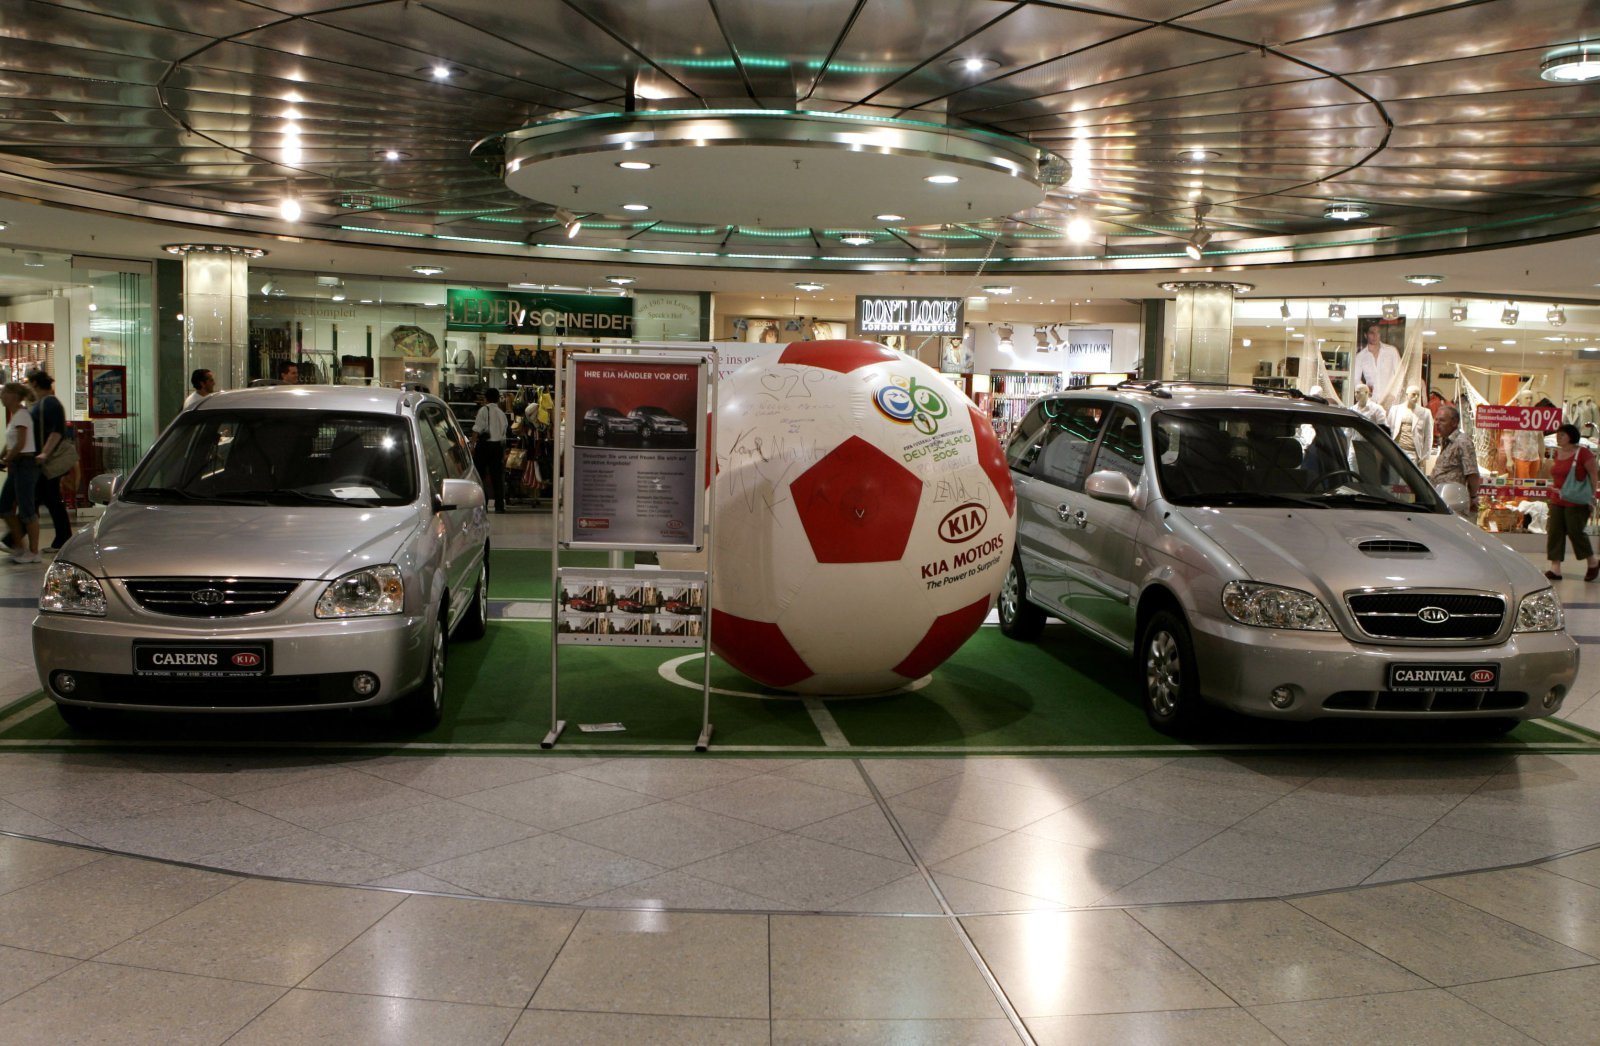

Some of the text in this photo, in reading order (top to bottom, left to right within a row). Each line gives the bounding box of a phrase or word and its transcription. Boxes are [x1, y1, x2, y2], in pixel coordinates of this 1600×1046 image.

[448, 296, 633, 331] LEDER SCHNEIDER
[862, 299, 958, 324] DON'T LOOK!
[862, 322, 957, 333] LONDON HAMBURG
[584, 368, 689, 381] IHRE KIA HÄNDLER VOR ORT.
[1519, 408, 1560, 431] 30%
[903, 434, 972, 463] DEUTSCHLAND
[932, 447, 959, 462] 2006
[947, 509, 982, 537] KIA
[921, 533, 1004, 579] KIA MOTORS
[926, 555, 1001, 591] The Power to Surprise
[1423, 610, 1445, 620] KIA
[152, 653, 256, 665] CARENS KIA
[1395, 670, 1490, 682] CARNIVAL KIA
